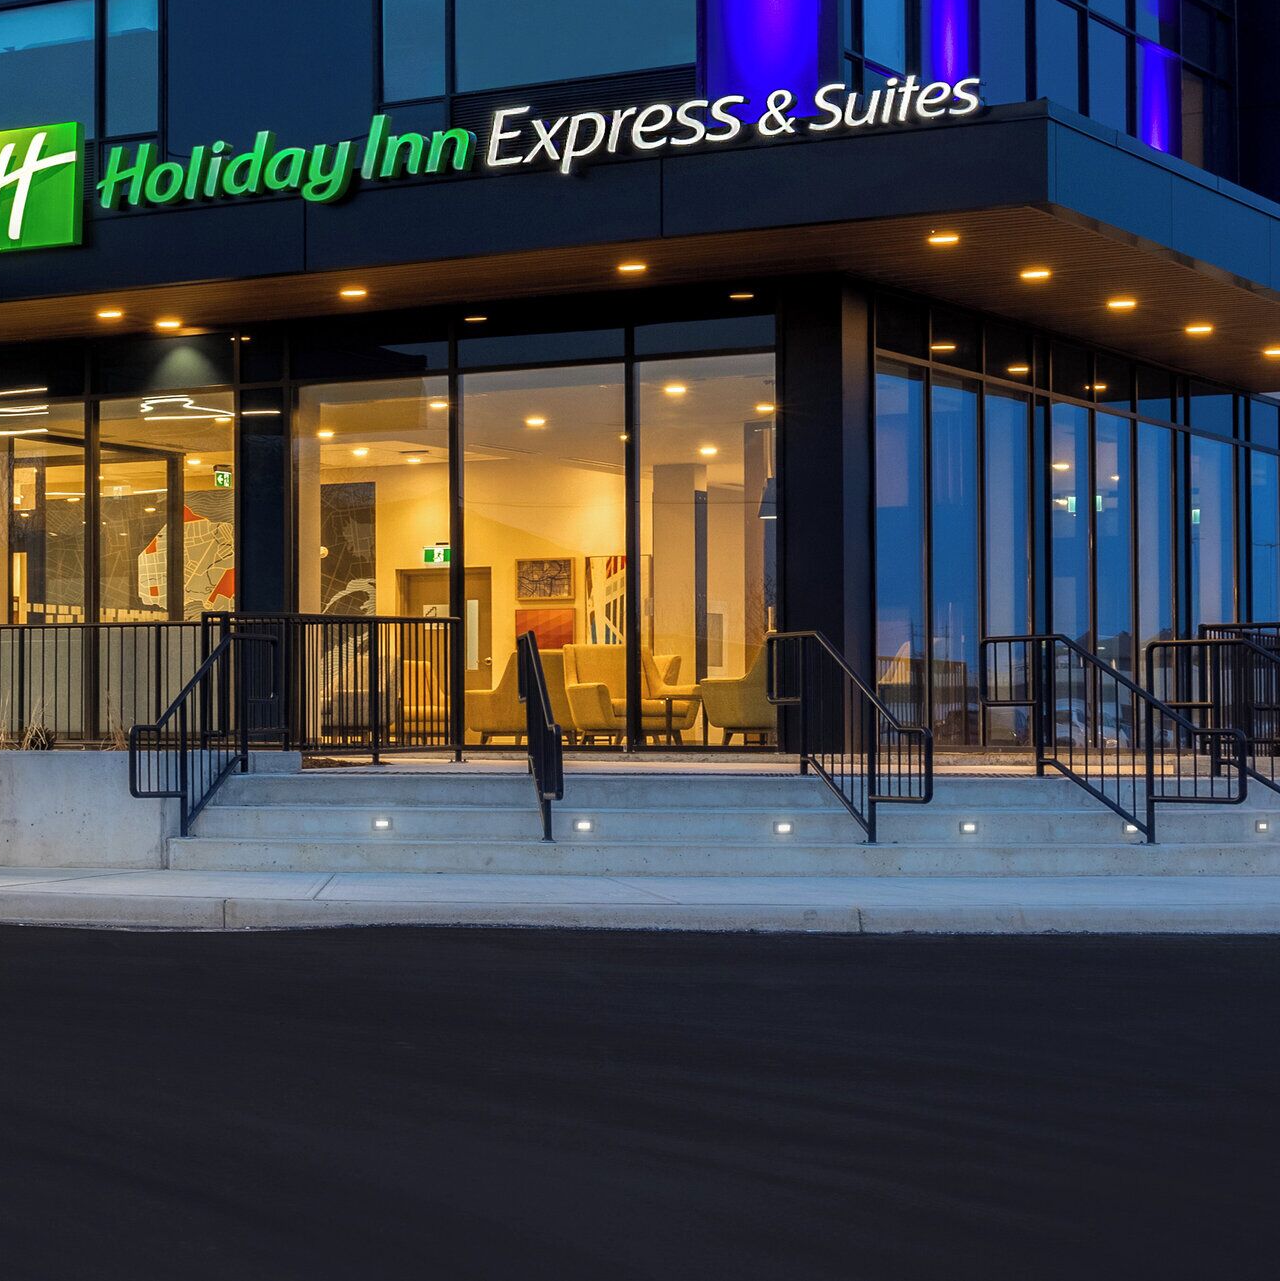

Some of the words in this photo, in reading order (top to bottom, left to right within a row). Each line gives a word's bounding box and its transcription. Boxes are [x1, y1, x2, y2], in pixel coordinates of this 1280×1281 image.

[95, 130, 354, 204] Holiday
[360, 114, 474, 180] Inn
[485, 94, 746, 175] Express
[757, 88, 798, 136] &
[807, 74, 982, 131] Suites
